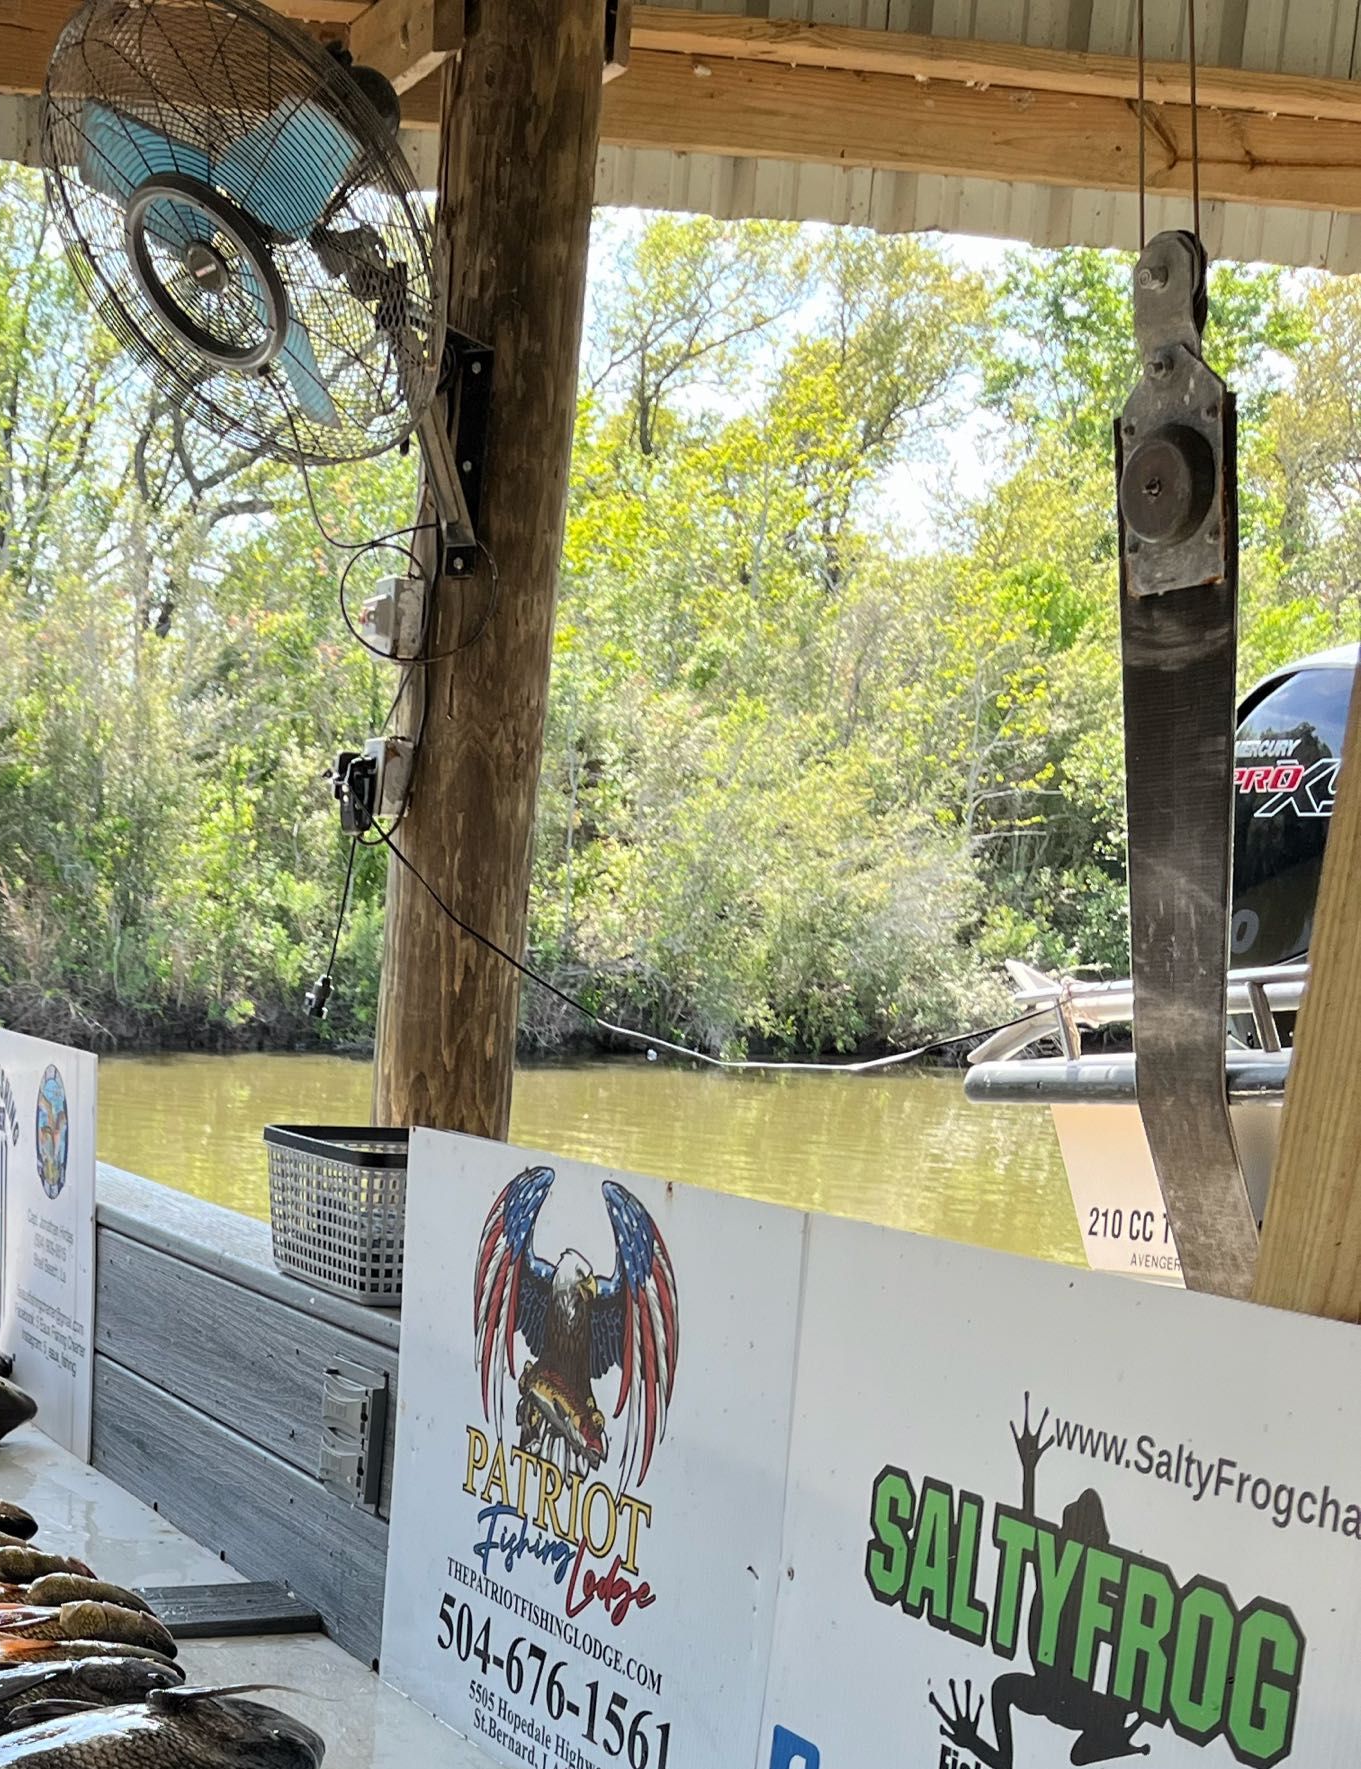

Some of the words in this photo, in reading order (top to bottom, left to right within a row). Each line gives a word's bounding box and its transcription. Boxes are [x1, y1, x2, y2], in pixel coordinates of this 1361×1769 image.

[1087, 1206, 1123, 1239] 210
[1129, 1209, 1155, 1242] CC
[1129, 1252, 1182, 1272] AVENGER
[462, 1424, 653, 1577] PATRIOT
[473, 1501, 576, 1585] Fishing
[565, 1536, 657, 1627] Lodge
[447, 1556, 663, 1697] THEPATRIOTFISHINGLODGE.COM
[468, 1679, 496, 1712] 5505
[497, 1695, 553, 1751] Hopedale
